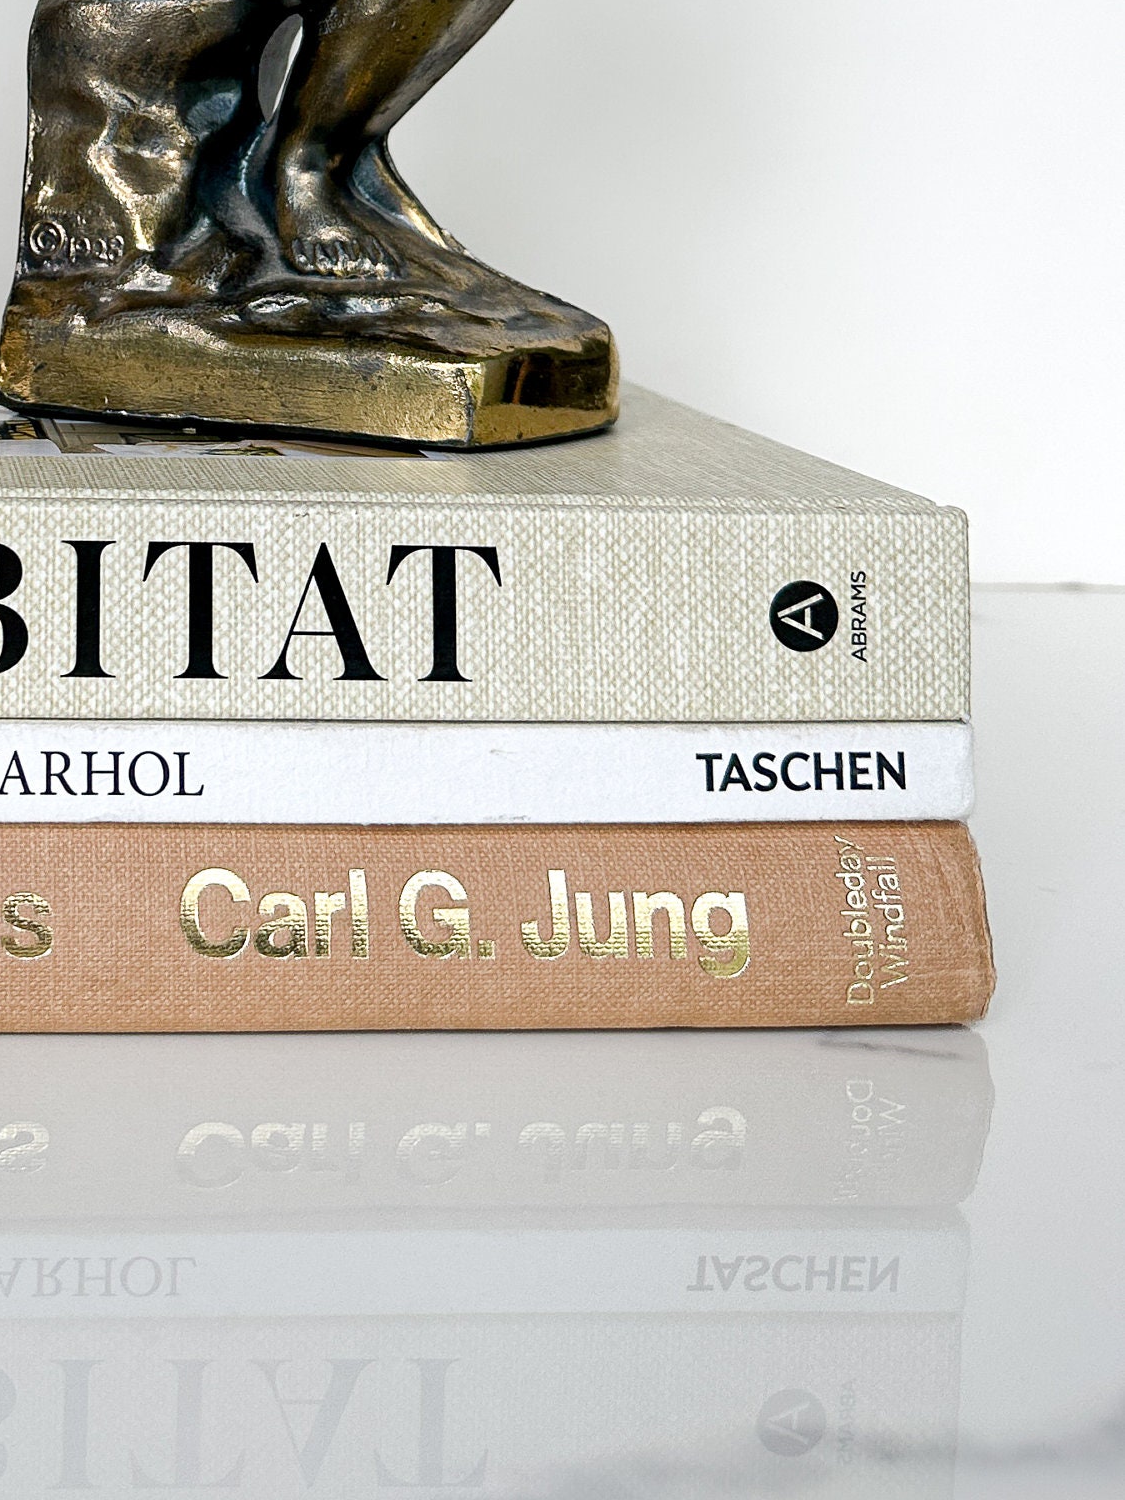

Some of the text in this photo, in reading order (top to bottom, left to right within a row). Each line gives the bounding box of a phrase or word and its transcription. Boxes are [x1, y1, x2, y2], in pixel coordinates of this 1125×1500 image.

[850, 570, 867, 662] ABRAMS
[695, 751, 907, 792] TASCHEN
[178, 867, 751, 980] Carl G. Jung
[834, 834, 875, 1005] Doubleday
[865, 855, 909, 989] Windfall
